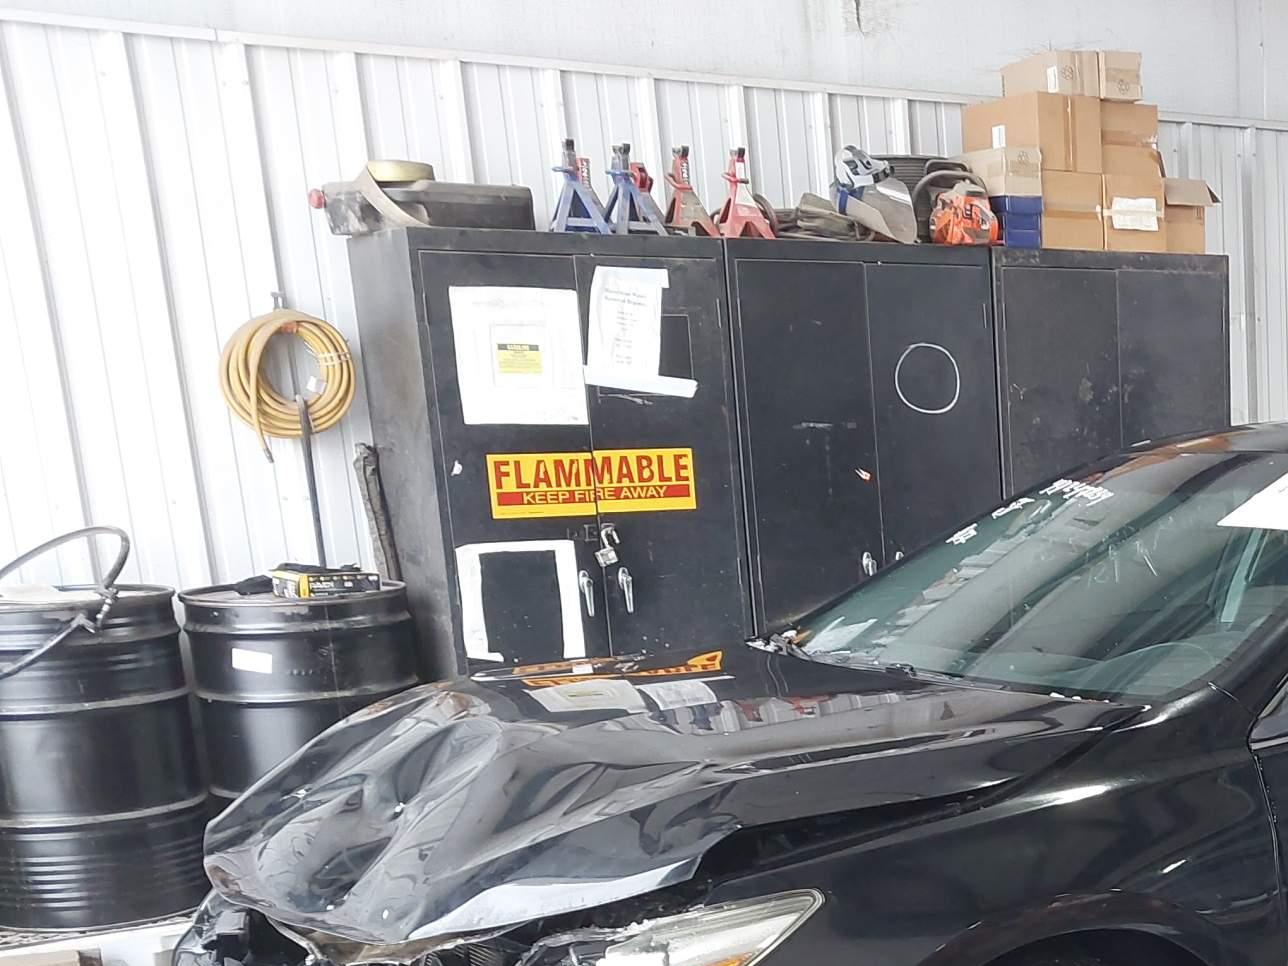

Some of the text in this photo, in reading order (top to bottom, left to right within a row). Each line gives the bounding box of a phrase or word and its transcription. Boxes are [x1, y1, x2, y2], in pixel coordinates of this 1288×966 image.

[493, 454, 690, 489] FLAMMABLE
[523, 486, 667, 505] KEEP FIRE AWAY
